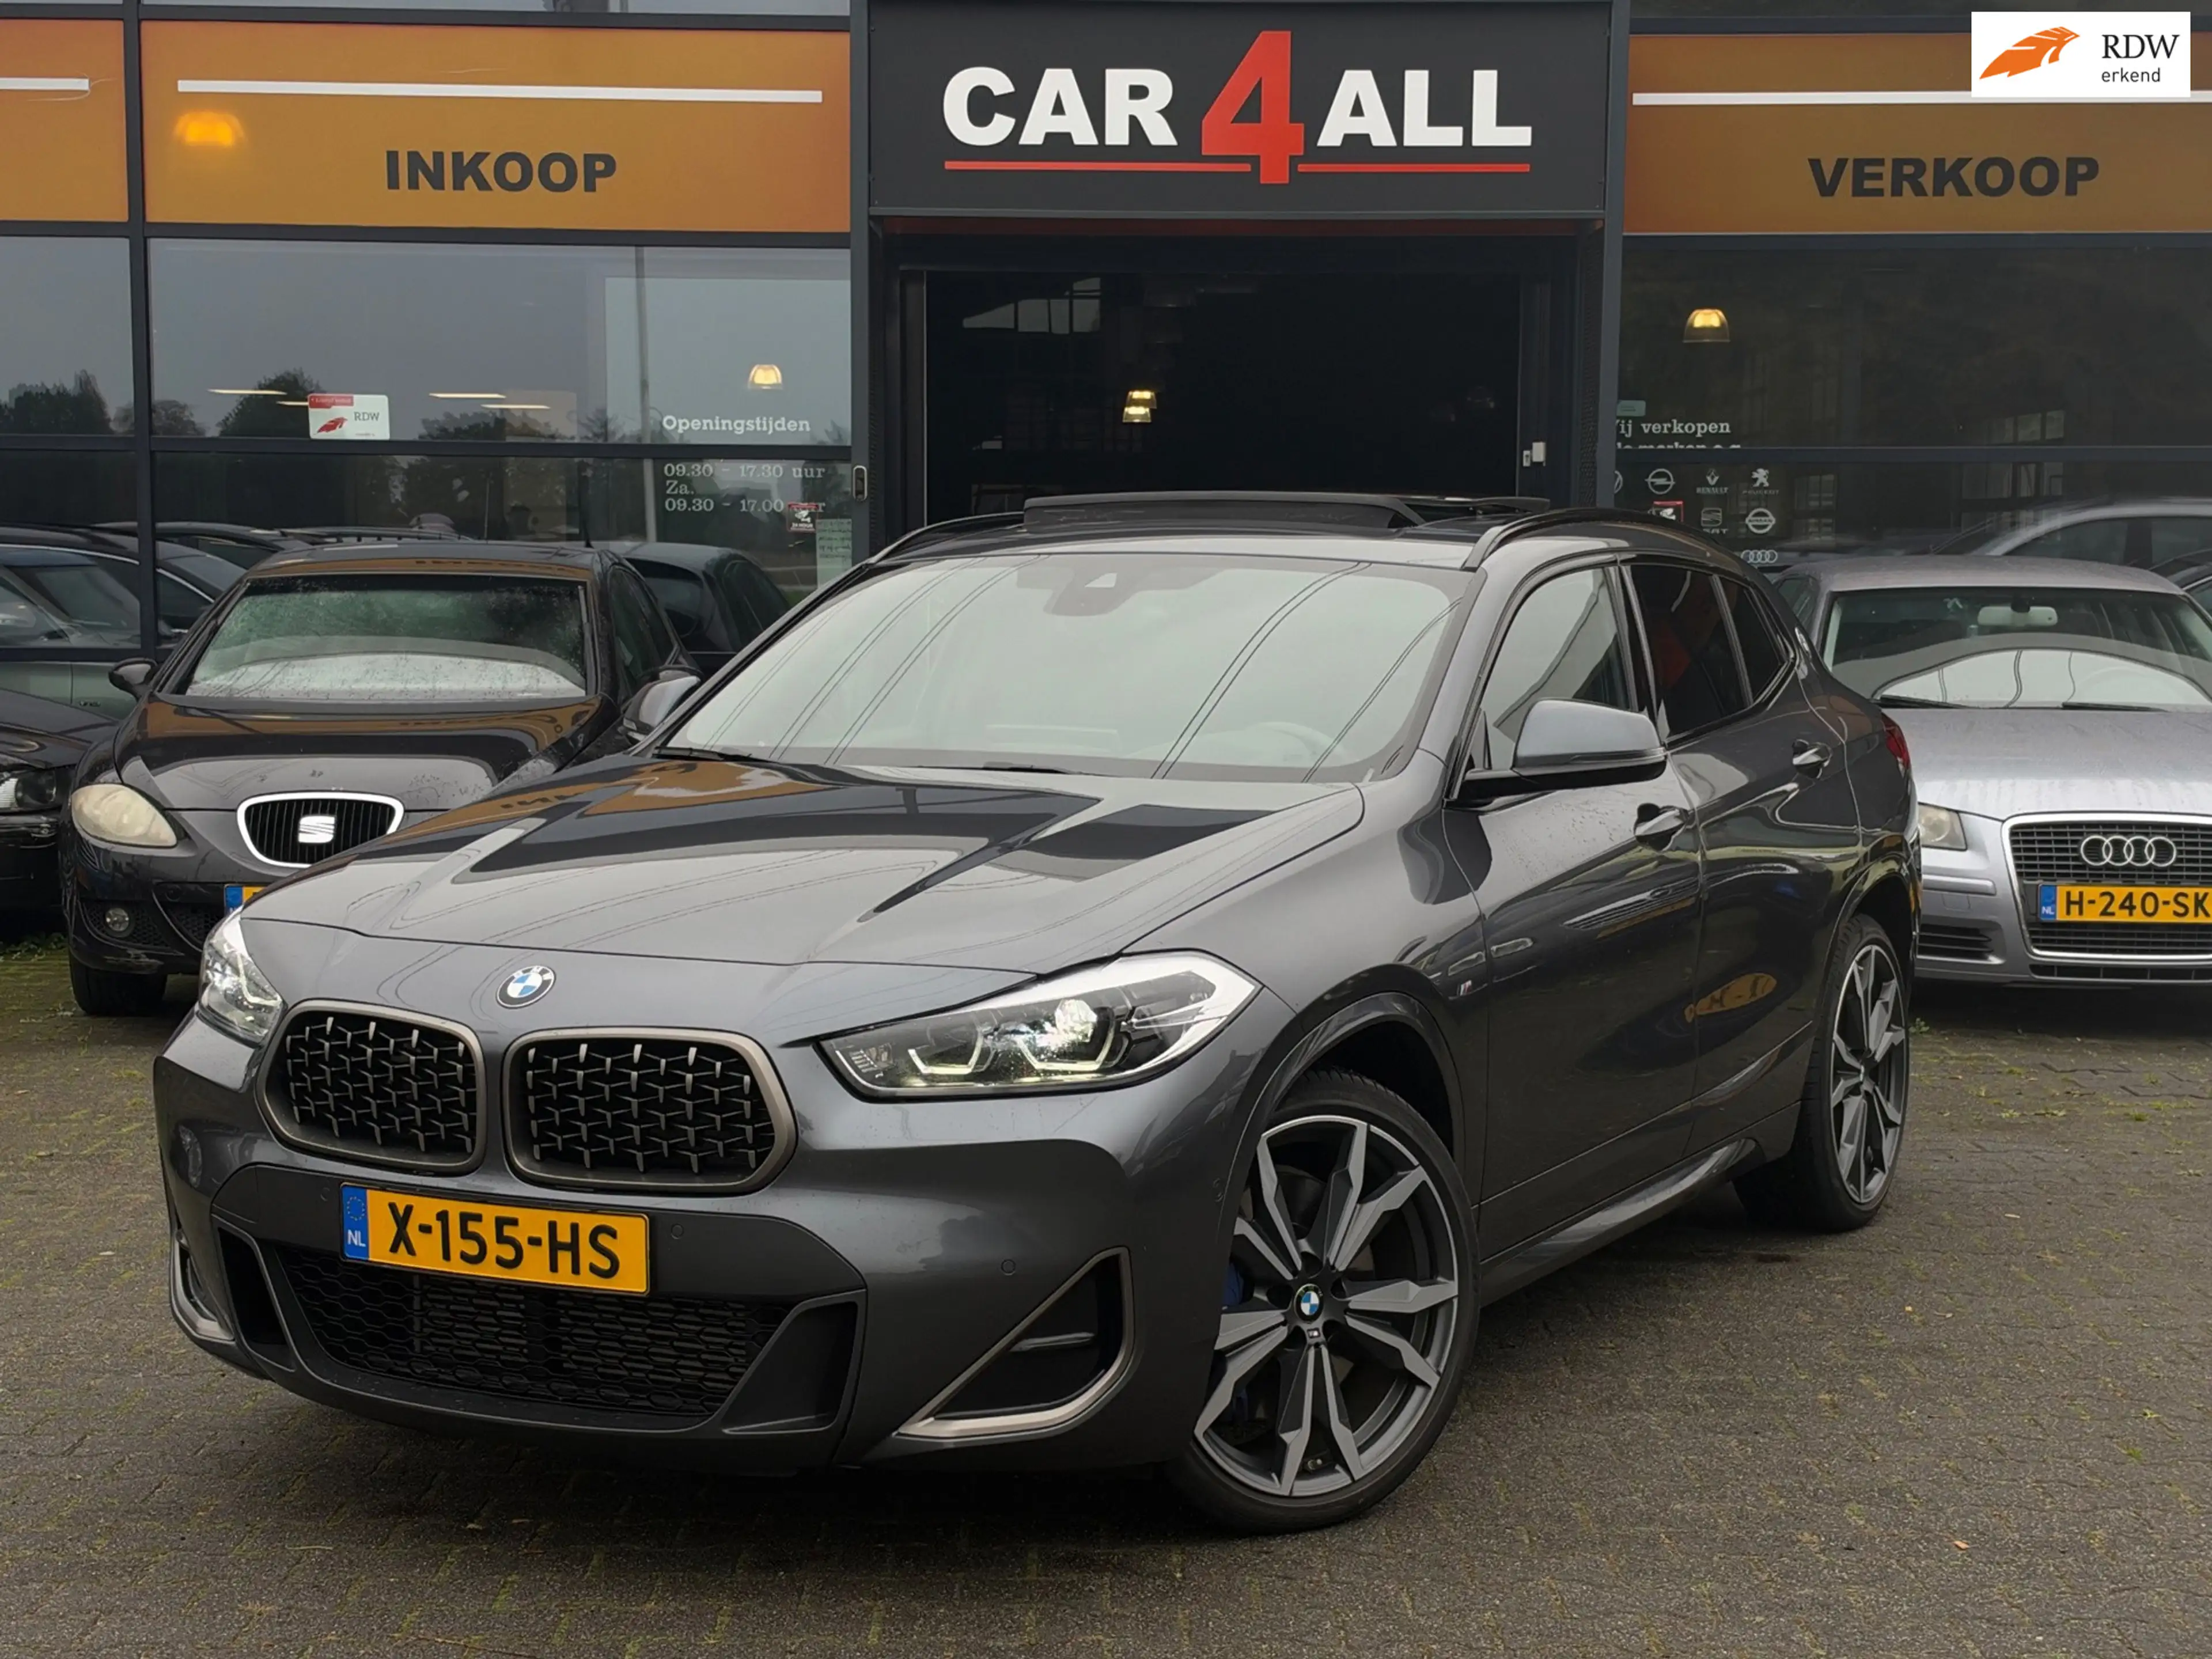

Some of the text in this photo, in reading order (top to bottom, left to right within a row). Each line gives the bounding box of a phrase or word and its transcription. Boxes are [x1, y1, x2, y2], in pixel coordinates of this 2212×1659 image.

[942, 30, 1532, 184] CAR 4 ALL
[385, 150, 617, 192] INKOOP
[1808, 156, 2099, 198] VERKOOP
[353, 411, 380, 422] RDW
[662, 415, 811, 435] Openingstijden
[1615, 419, 1731, 438] ij verkopen
[664, 463, 714, 478] 09.30
[739, 464, 784, 478] 17.30
[791, 466, 826, 479] uur
[665, 480, 695, 495] Za.
[665, 498, 714, 512] 09.30
[740, 499, 785, 513] 17.00
[2041, 905, 2055, 916] NL
[2065, 890, 2211, 918] H-240-SK
[347, 1229, 366, 1248] NL
[387, 1201, 620, 1279] X-155-HS
